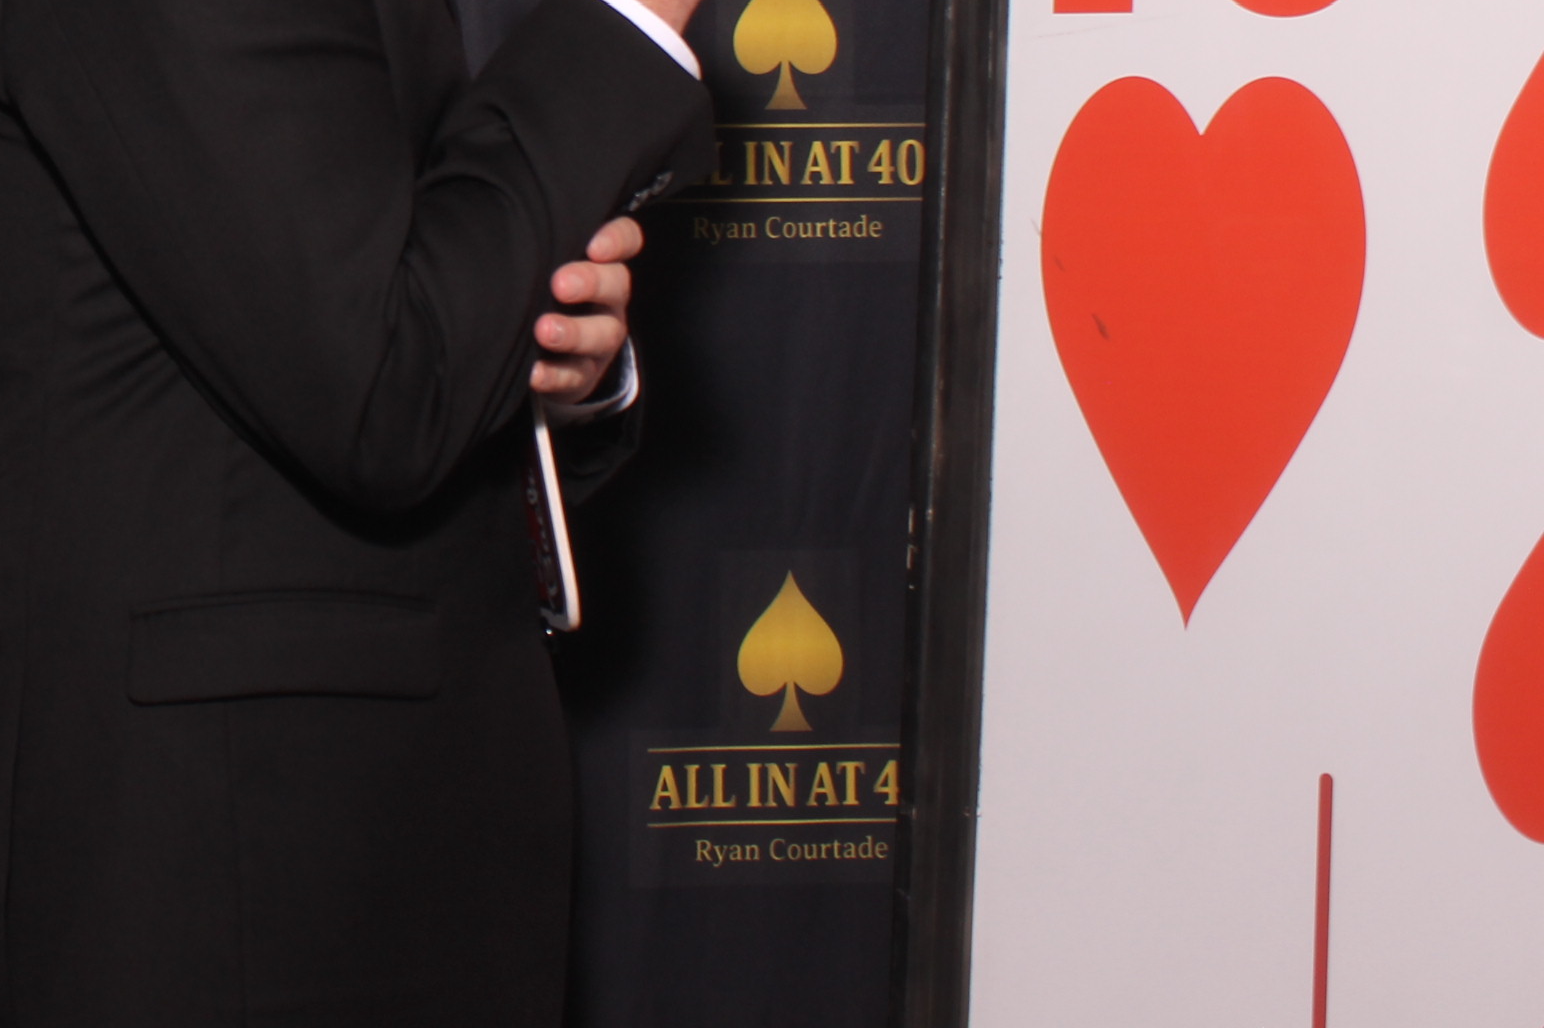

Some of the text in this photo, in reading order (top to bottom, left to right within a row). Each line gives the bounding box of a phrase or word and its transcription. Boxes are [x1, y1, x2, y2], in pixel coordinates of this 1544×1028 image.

[743, 140, 794, 186] IN
[801, 140, 860, 185] AT
[867, 138, 925, 186] 40
[692, 213, 884, 246] Ryan Courtade
[650, 759, 900, 811] ALL IN AT 4
[695, 835, 889, 866] Ryan Courtade
